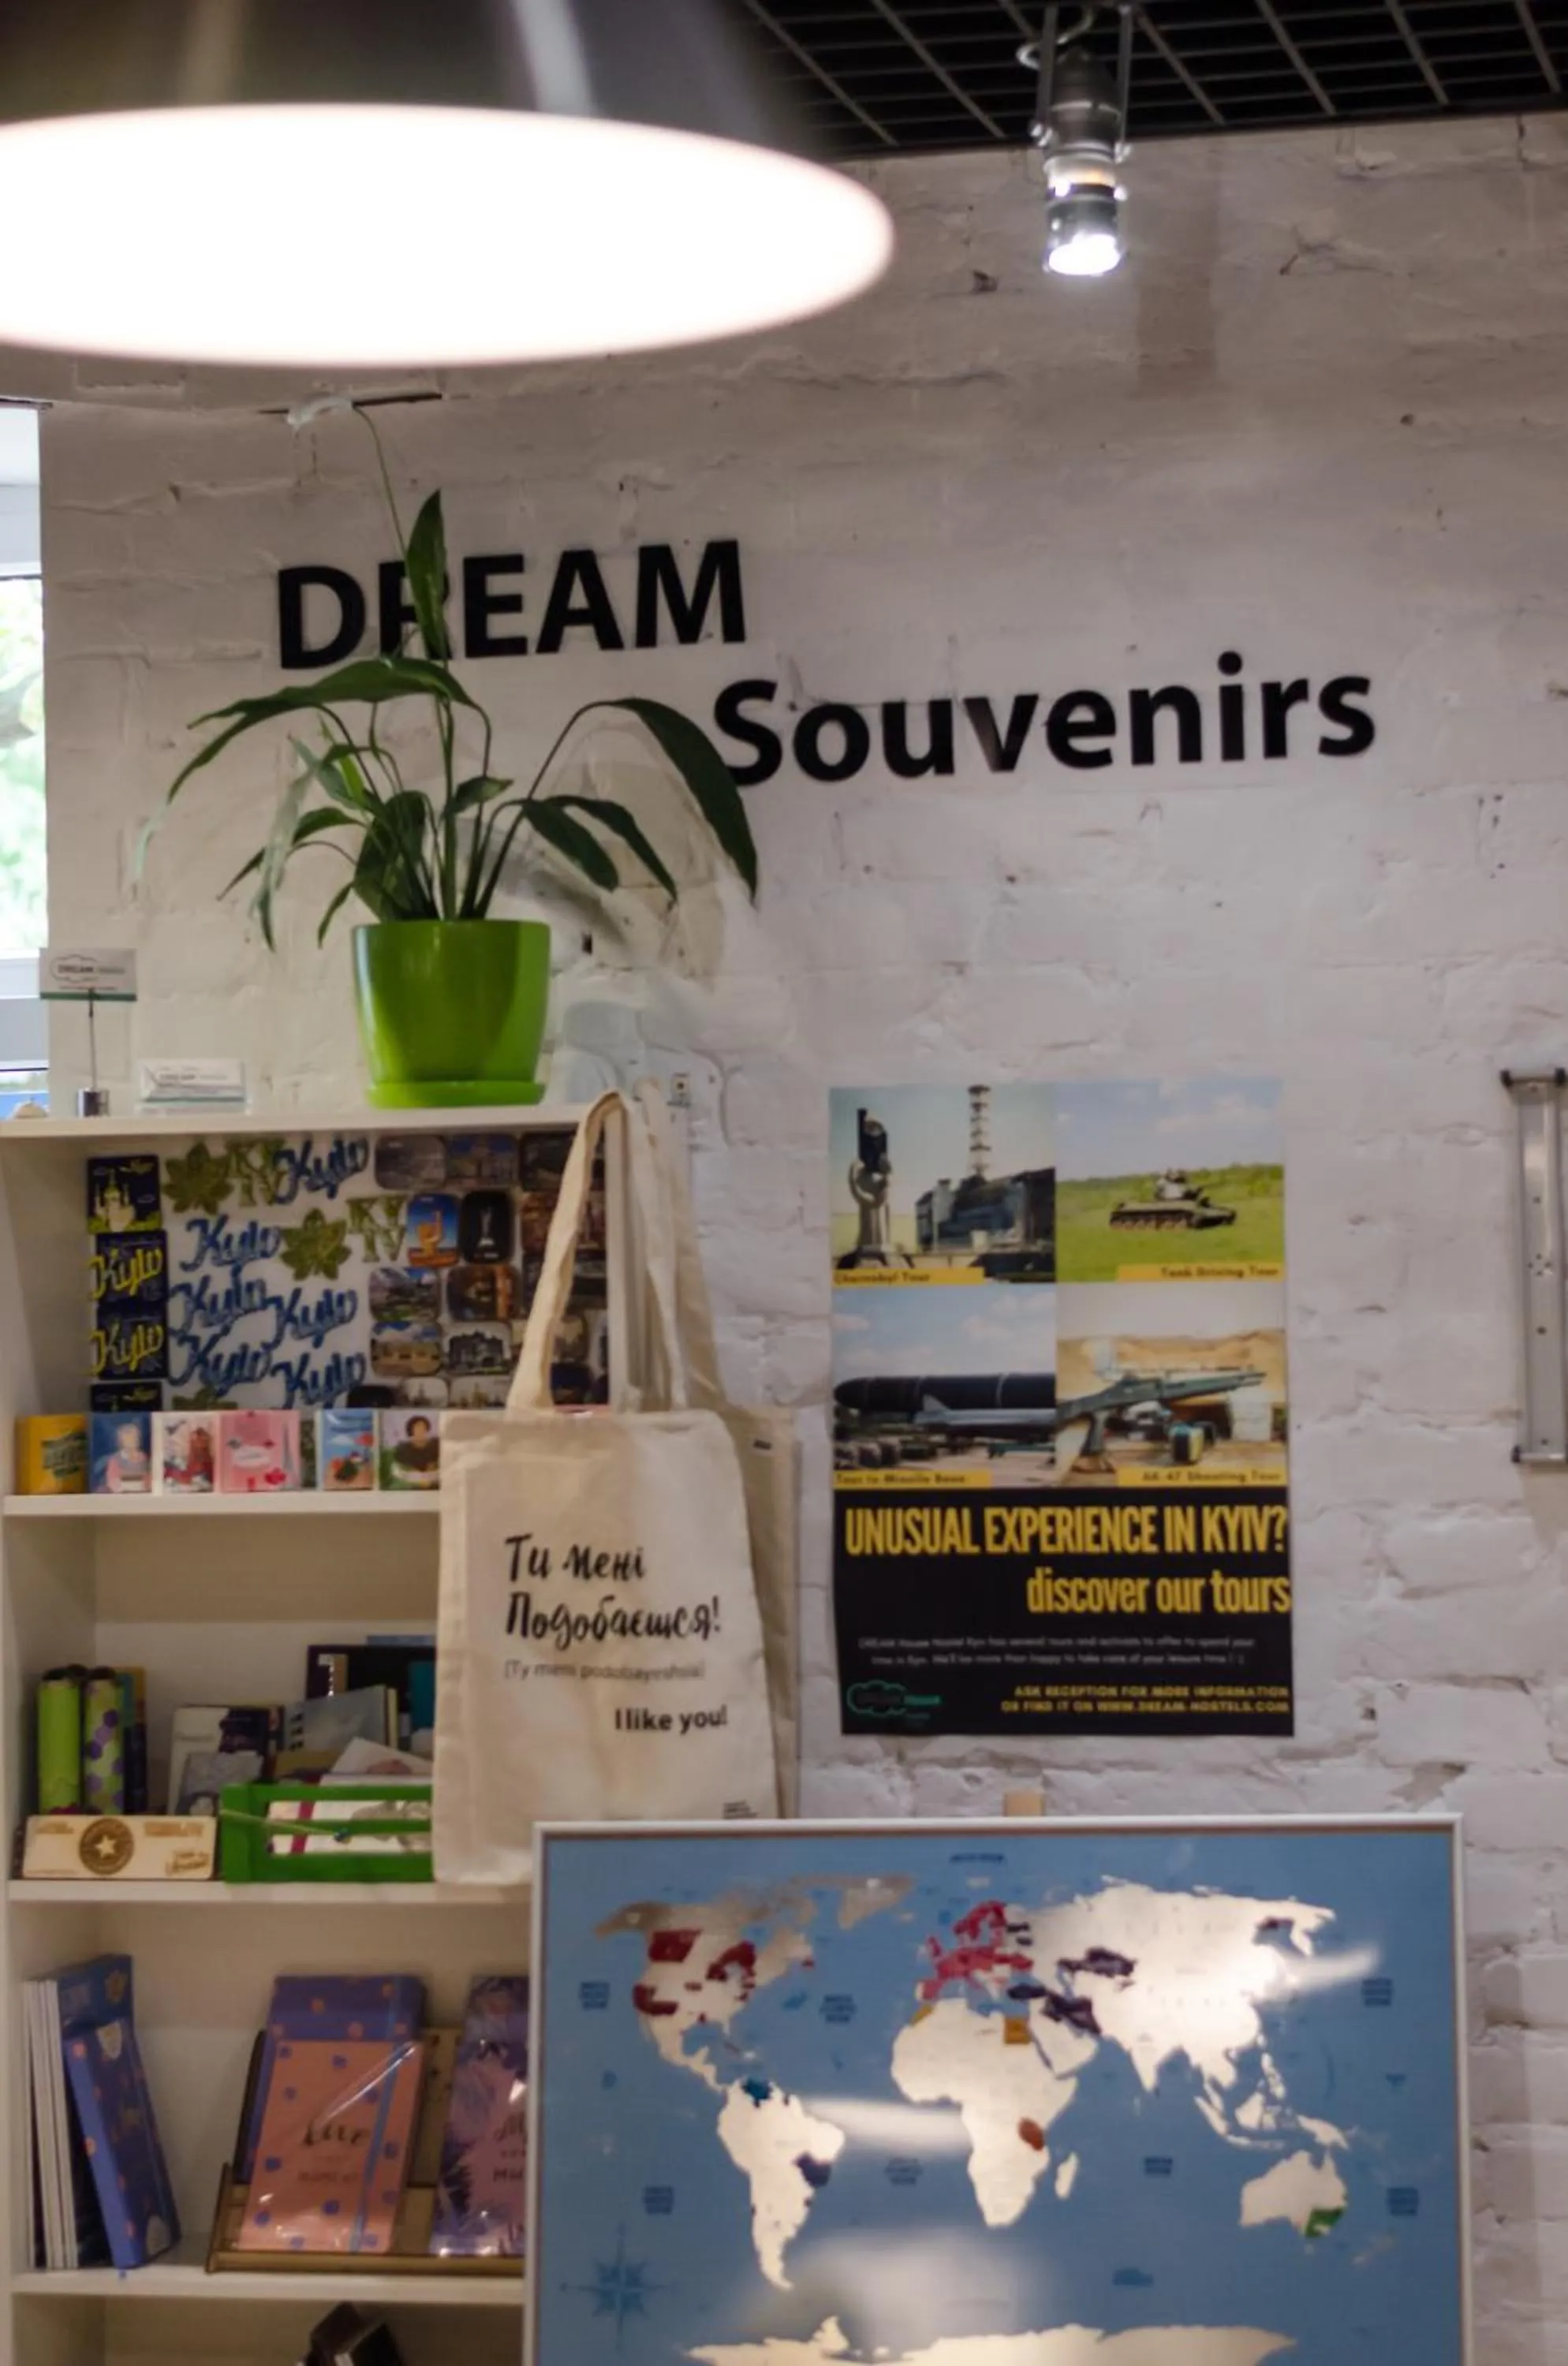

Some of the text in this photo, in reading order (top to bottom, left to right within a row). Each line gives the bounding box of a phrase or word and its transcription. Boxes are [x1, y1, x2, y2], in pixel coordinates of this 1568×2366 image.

[278, 539, 746, 670] DREAM
[714, 651, 1376, 786] Souvenirs
[846, 1505, 1290, 1556] UNUSUAL EXPERIENCE IN KYIV?
[506, 1533, 551, 1583] Ти
[1026, 1567, 1292, 1614] discover our tours
[614, 1708, 623, 1731] I
[625, 1707, 674, 1731] like
